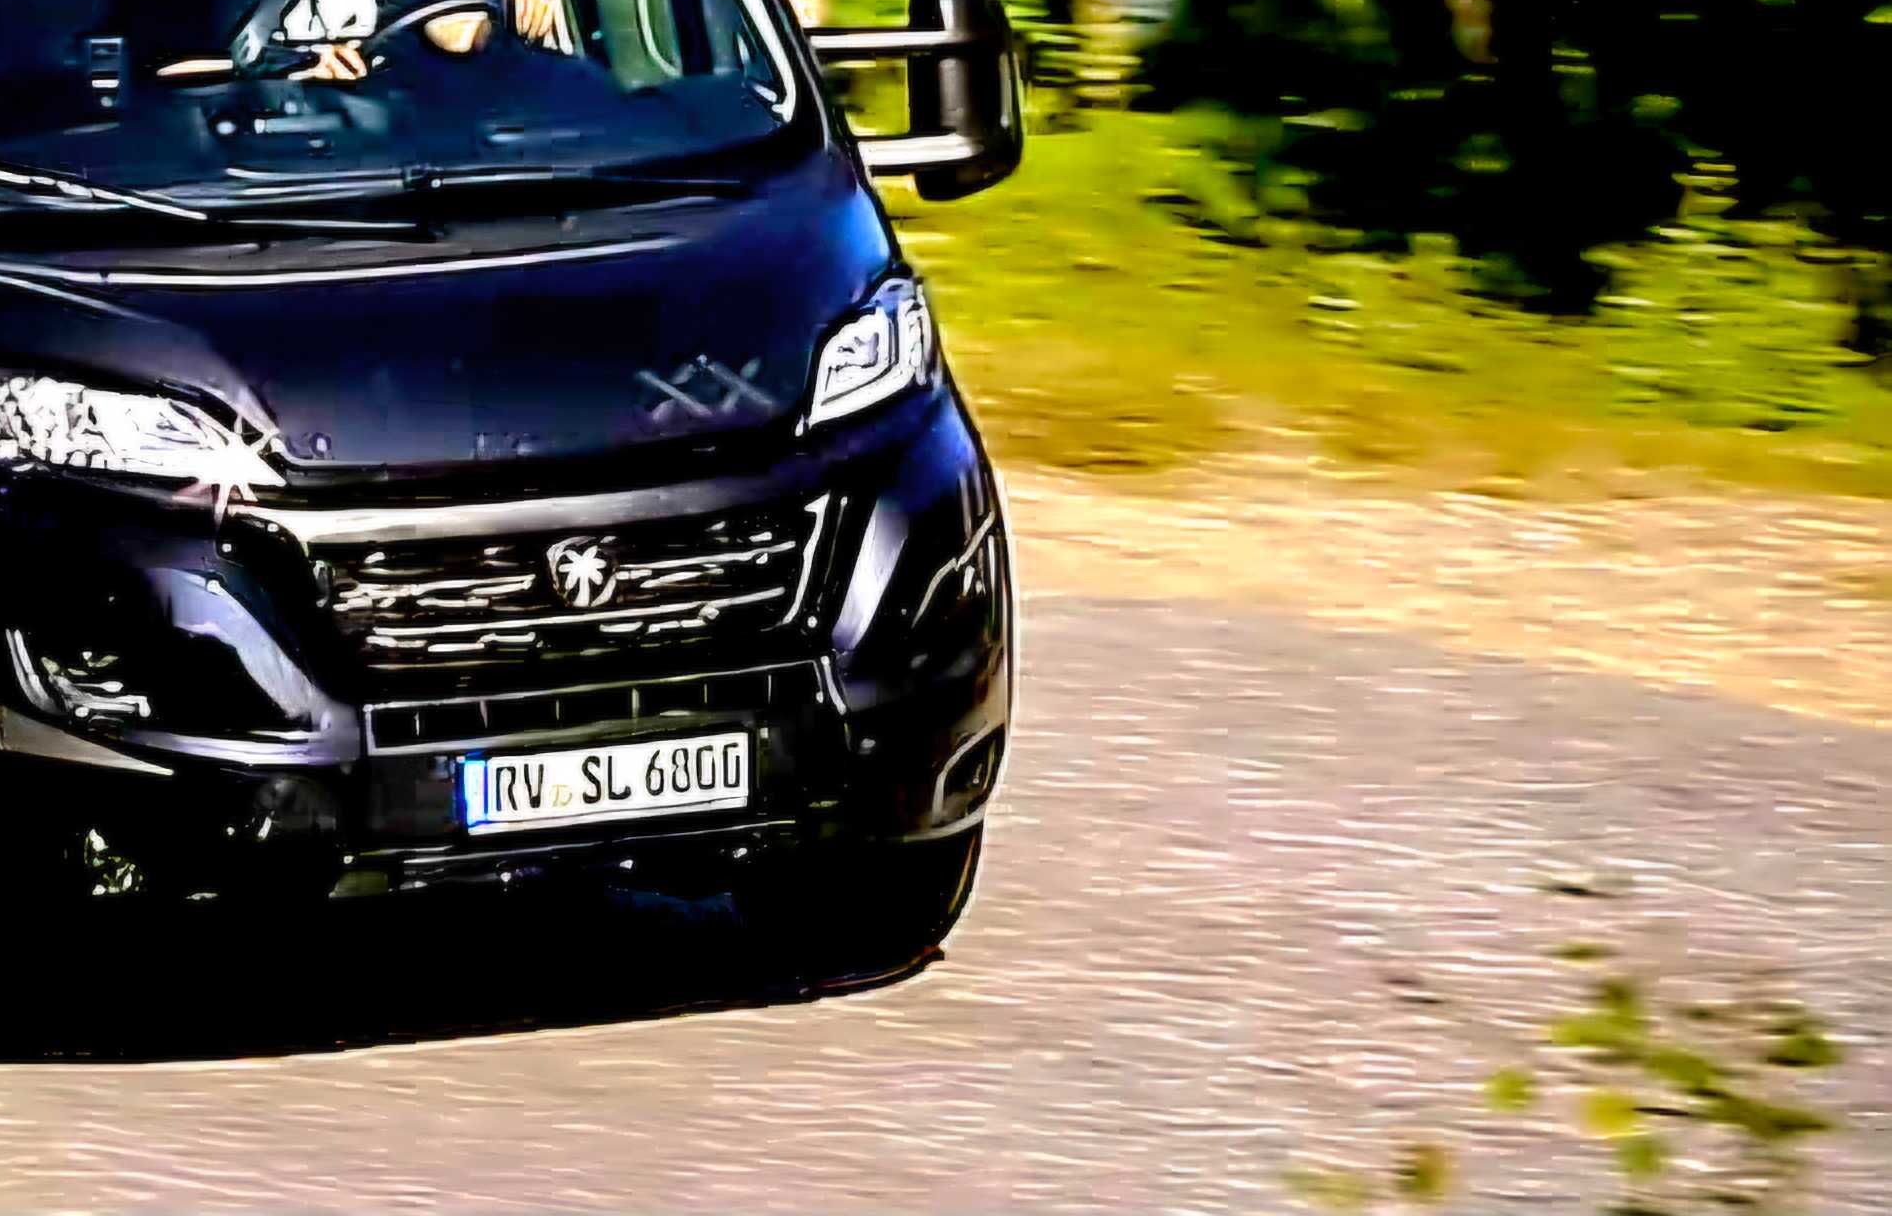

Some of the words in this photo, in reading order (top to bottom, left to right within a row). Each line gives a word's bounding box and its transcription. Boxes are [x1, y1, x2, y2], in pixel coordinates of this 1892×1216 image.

[495, 763, 545, 812] RV
[582, 755, 631, 804] SL
[645, 742, 740, 796] 6800
